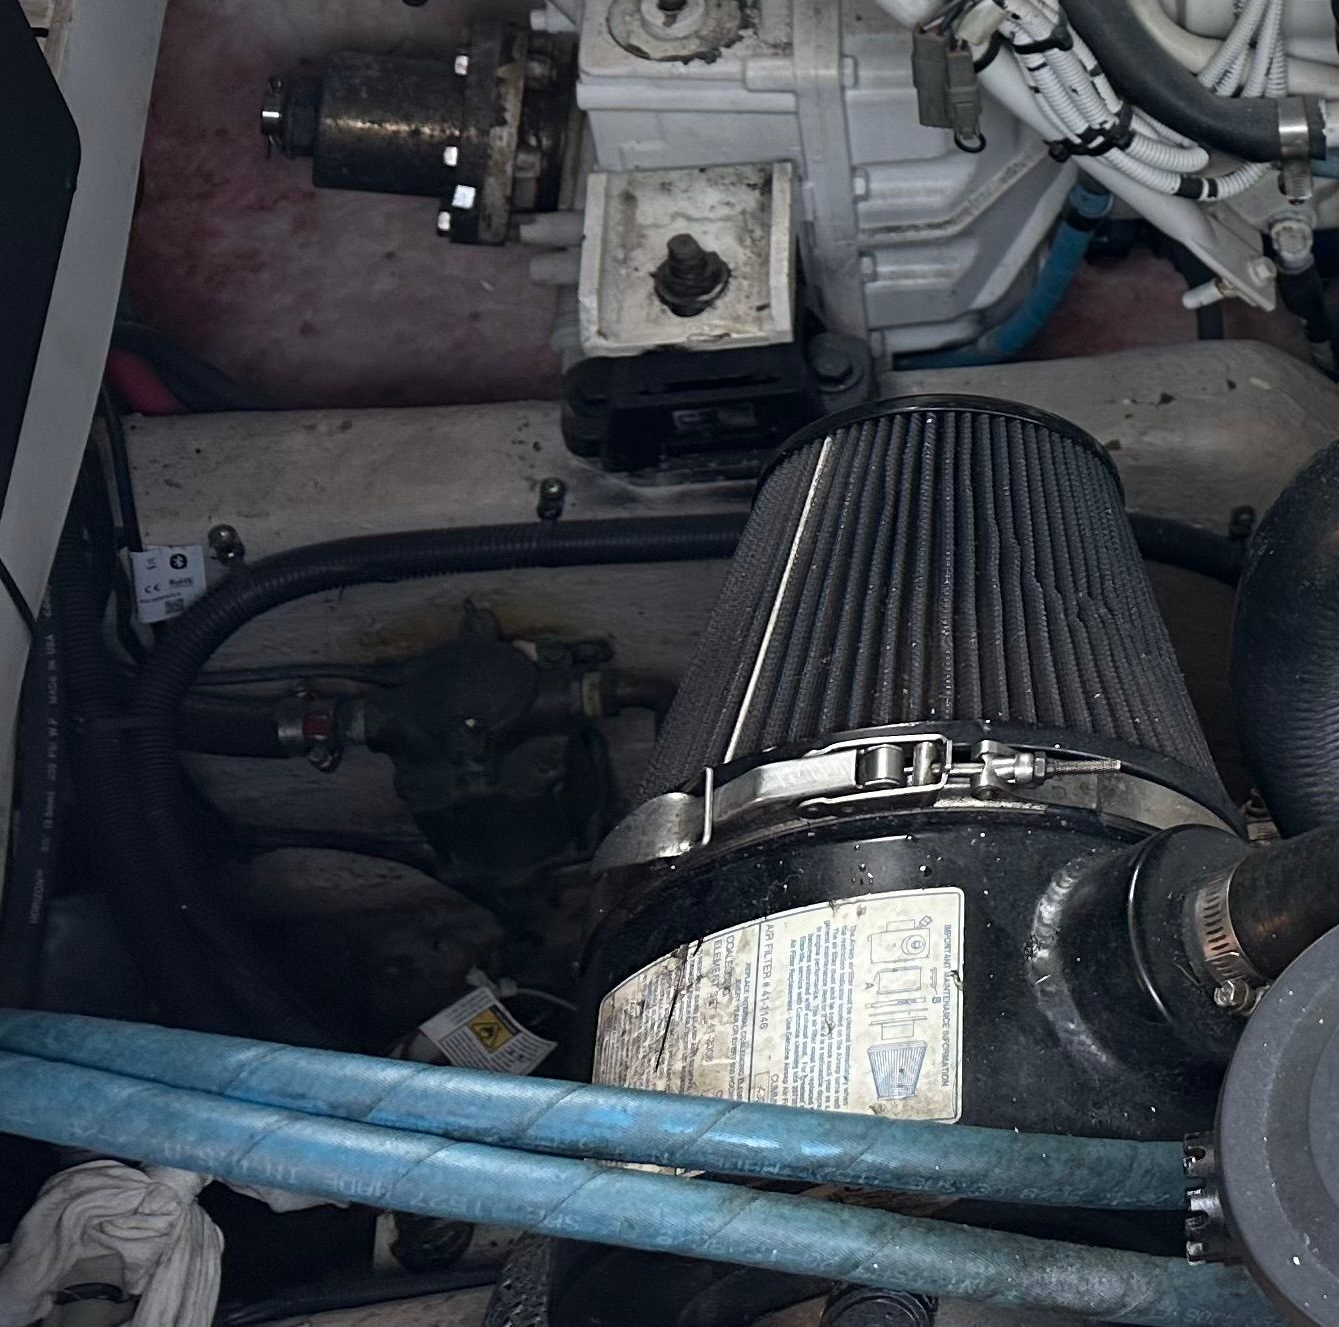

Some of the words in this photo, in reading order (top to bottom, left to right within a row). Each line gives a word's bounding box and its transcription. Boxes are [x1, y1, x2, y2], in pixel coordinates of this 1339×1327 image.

[45, 634, 56, 654] USA
[765, 924, 774, 940] AIR
[943, 924, 951, 968] IMPORTANT
[710, 939, 722, 987] ELEMENT
[762, 943, 772, 978] FILTER
[864, 982, 873, 990] A
[942, 971, 950, 1027] MAINTENANCE
[941, 1030, 949, 1086] INFORMATION
